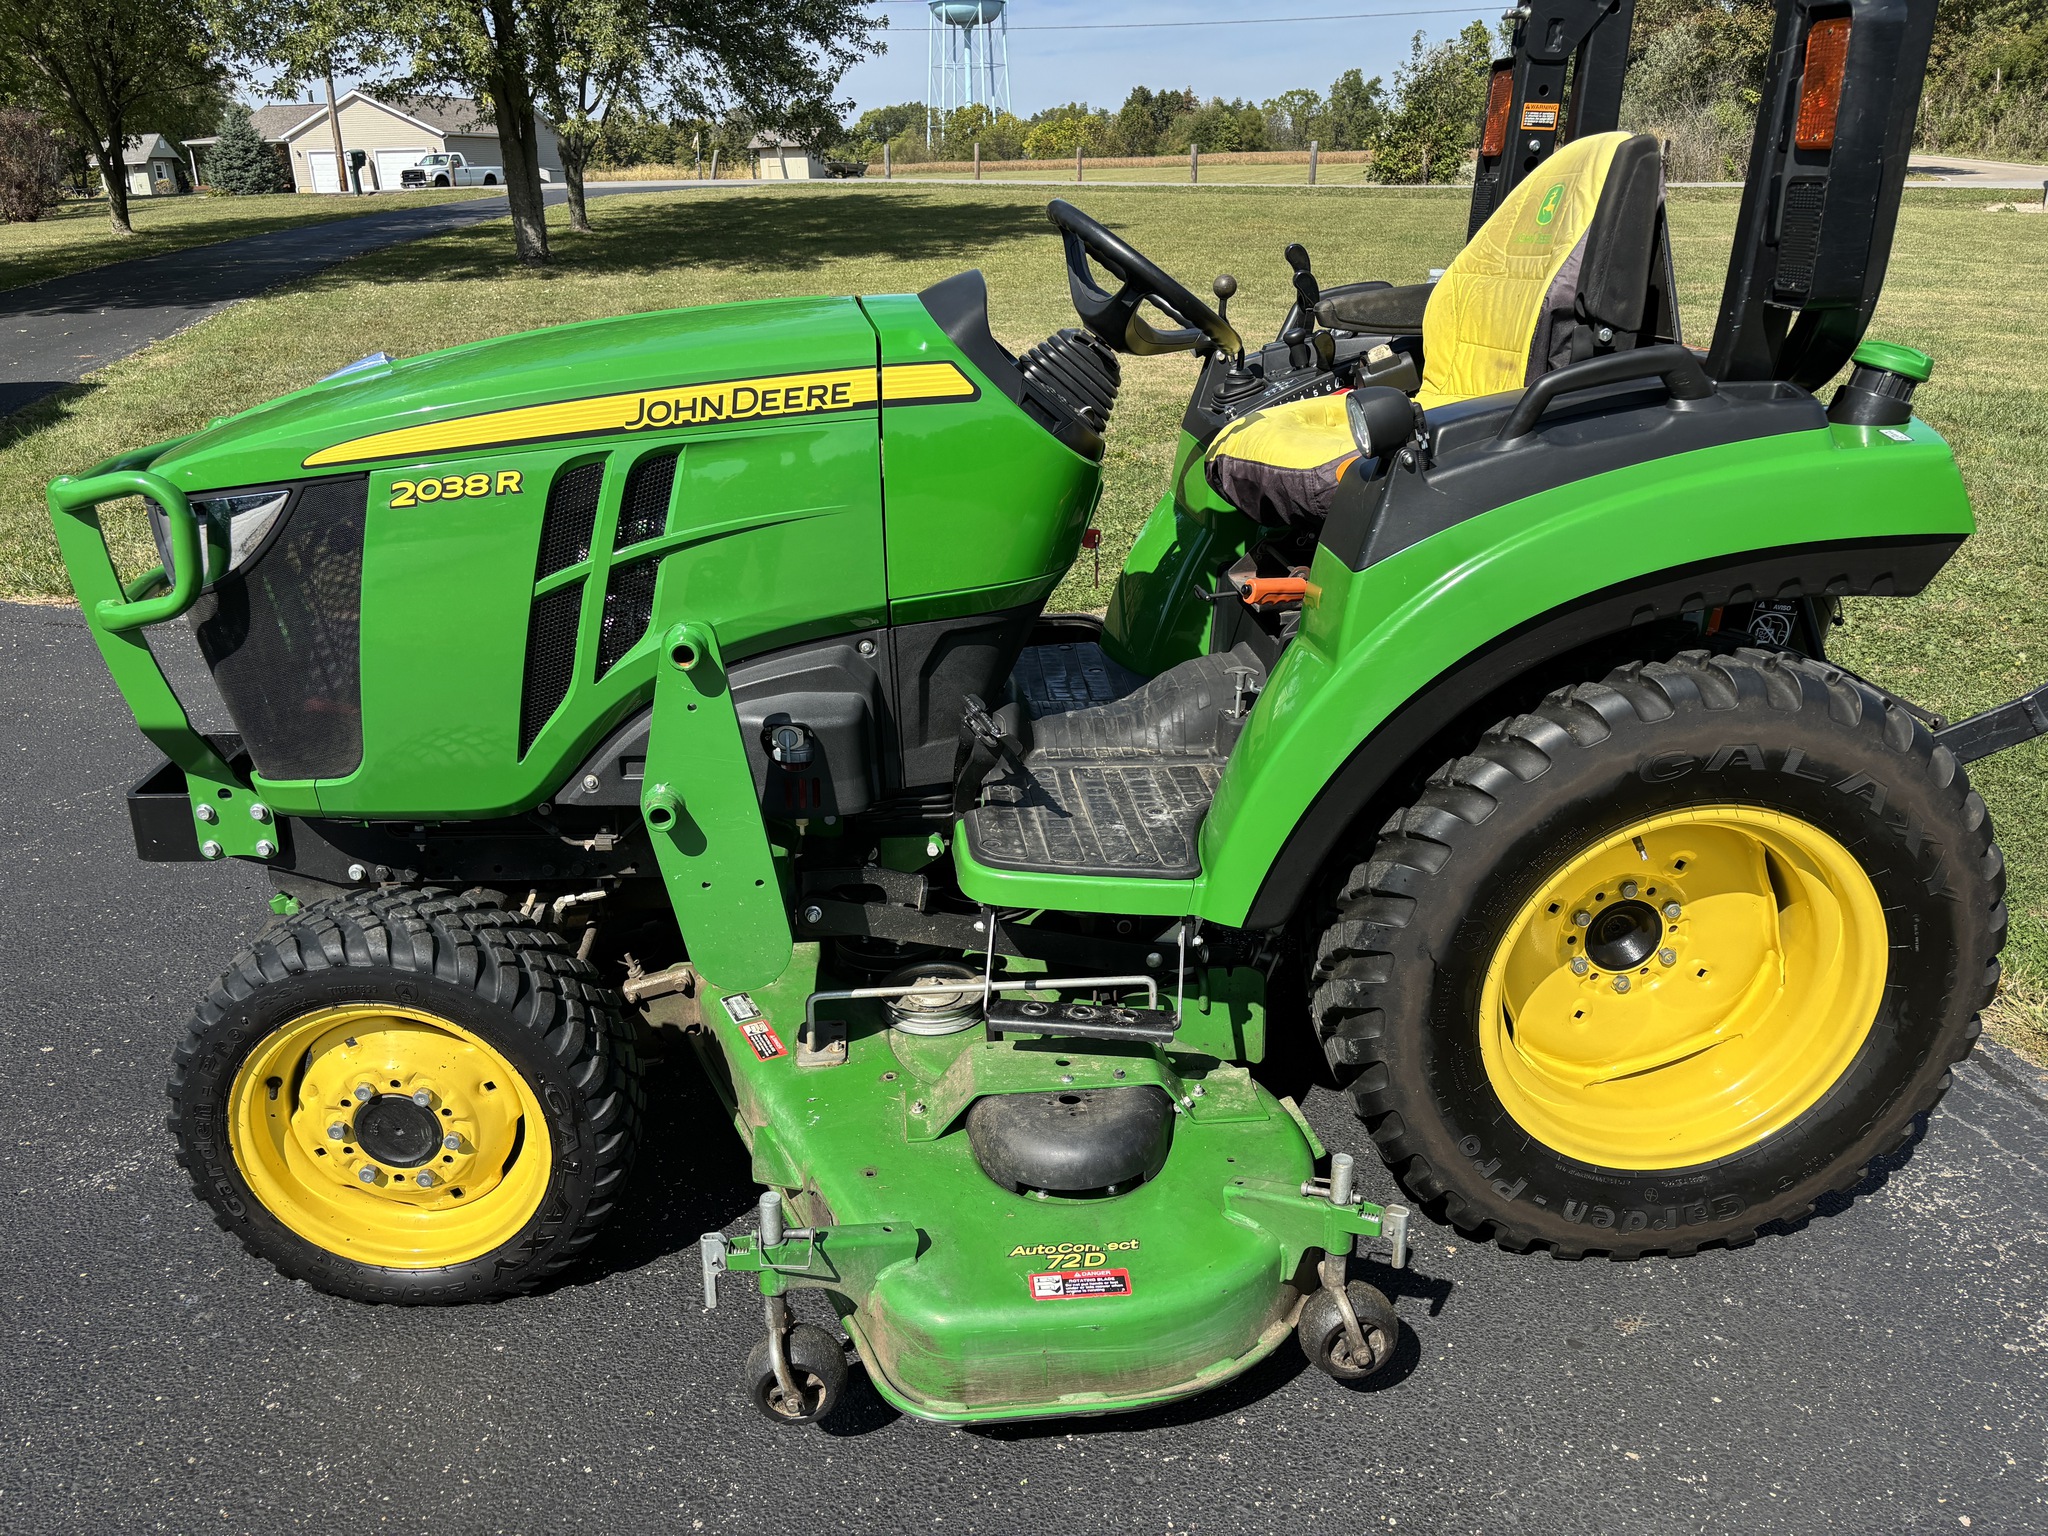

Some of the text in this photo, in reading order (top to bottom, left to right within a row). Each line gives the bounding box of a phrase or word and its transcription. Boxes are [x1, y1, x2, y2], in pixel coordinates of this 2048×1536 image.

[1325, 384, 1332, 392] 6
[625, 382, 851, 427] JOHN DEERE
[1638, 744, 1962, 901] GALAXY
[492, 1081, 580, 1282] GALAXY
[1008, 1238, 1140, 1257] AutoConect
[1045, 1252, 1107, 1270] 72D
